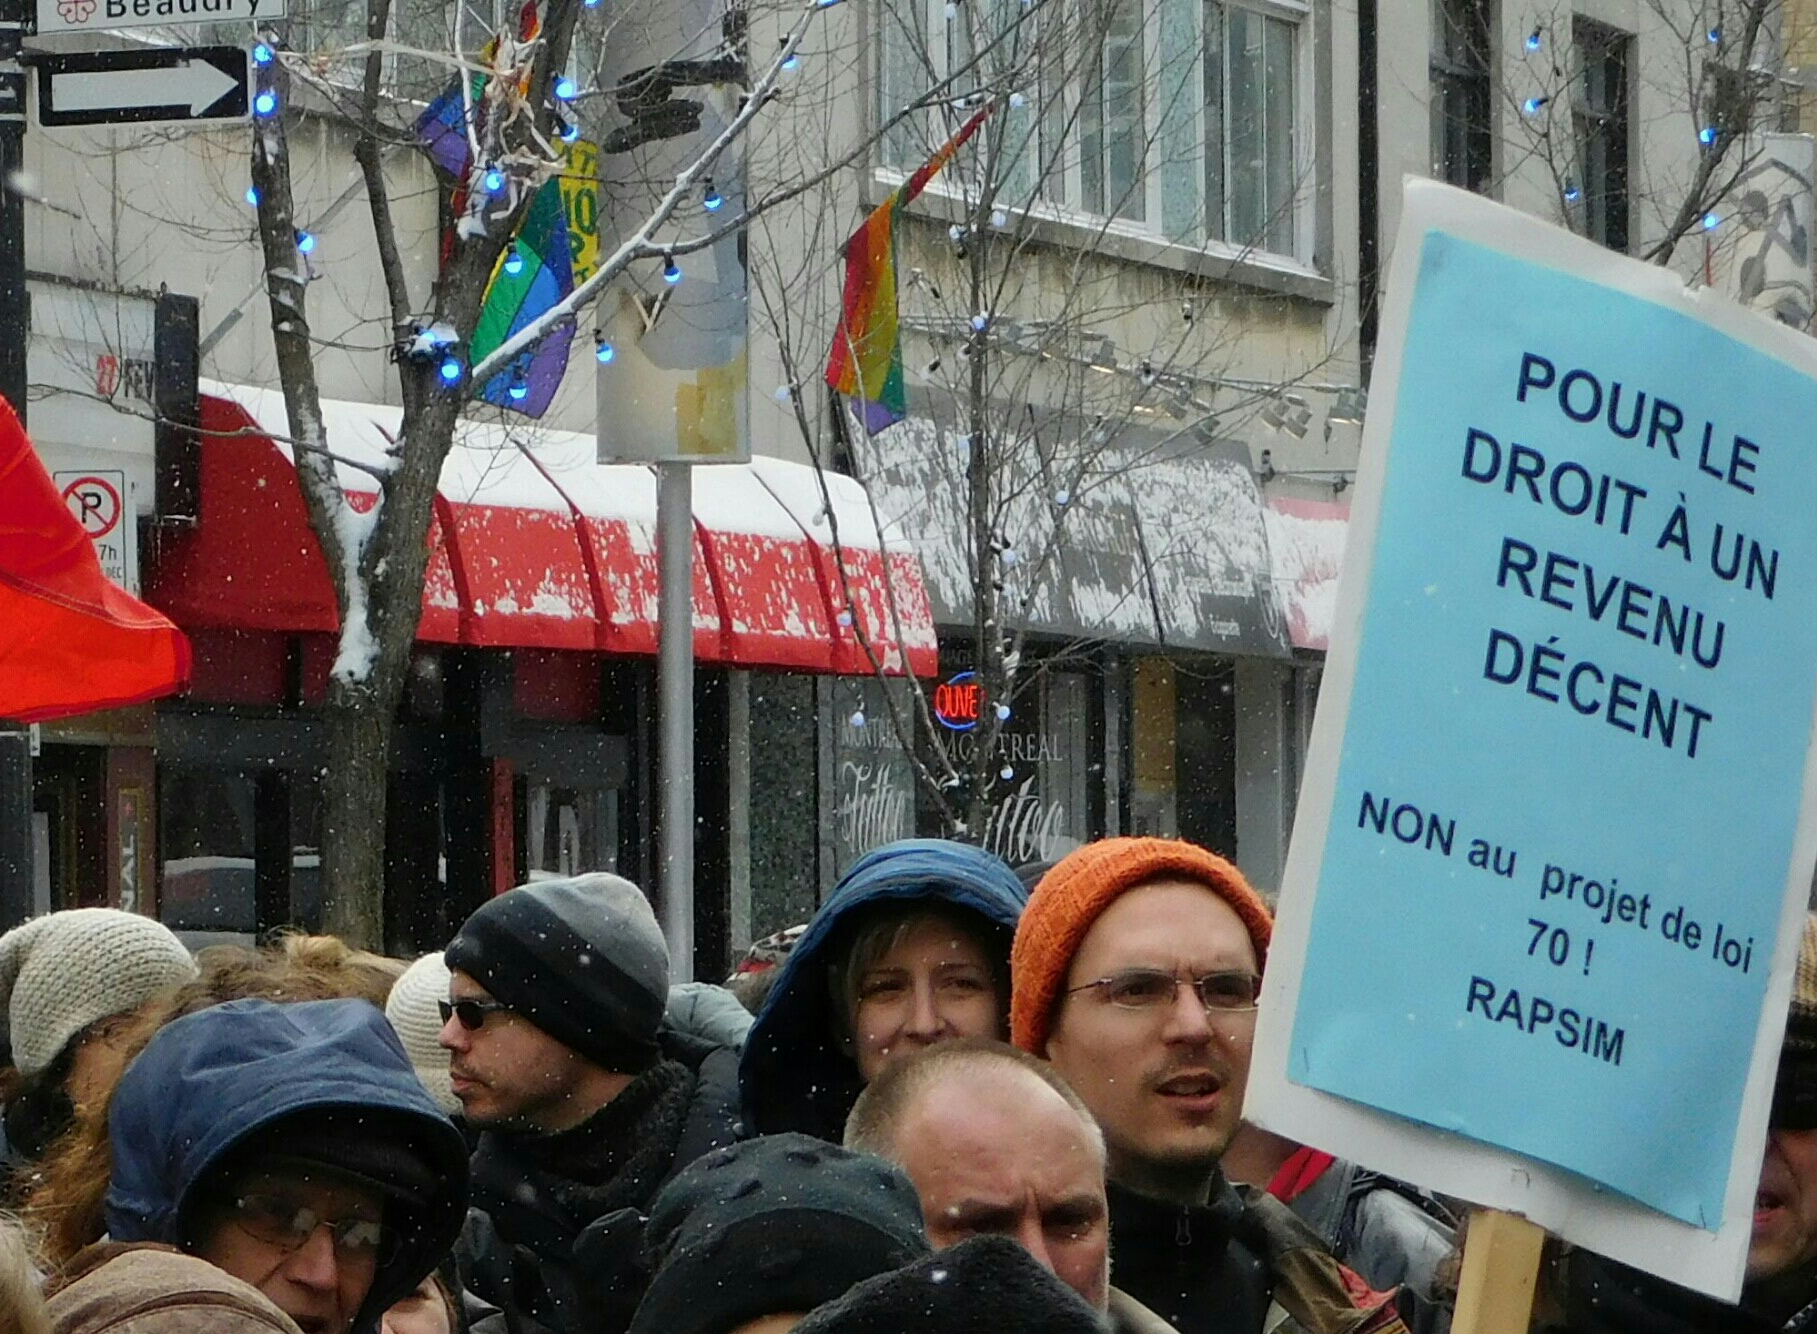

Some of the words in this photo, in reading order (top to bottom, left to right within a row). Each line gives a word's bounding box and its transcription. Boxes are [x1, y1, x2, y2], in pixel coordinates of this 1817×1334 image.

[1516, 351, 1684, 460] POUR
[1698, 421, 1760, 495] LE
[1461, 427, 1648, 535] DROIT
[1656, 490, 1692, 563] À
[1710, 522, 1779, 601] UN
[1496, 536, 1726, 670] REVENU
[935, 684, 987, 719] OUVE
[935, 732, 1063, 762] MOTREAL
[1483, 627, 1713, 760] DÉCENT
[1357, 790, 1456, 857] NON
[1467, 838, 1517, 878] au
[1540, 863, 1651, 930] projet
[1661, 905, 1702, 950] de
[1712, 923, 1754, 974] loi
[1526, 918, 1570, 967] 70
[1582, 938, 1595, 976] !
[1465, 975, 1625, 1067] RAPSIM
